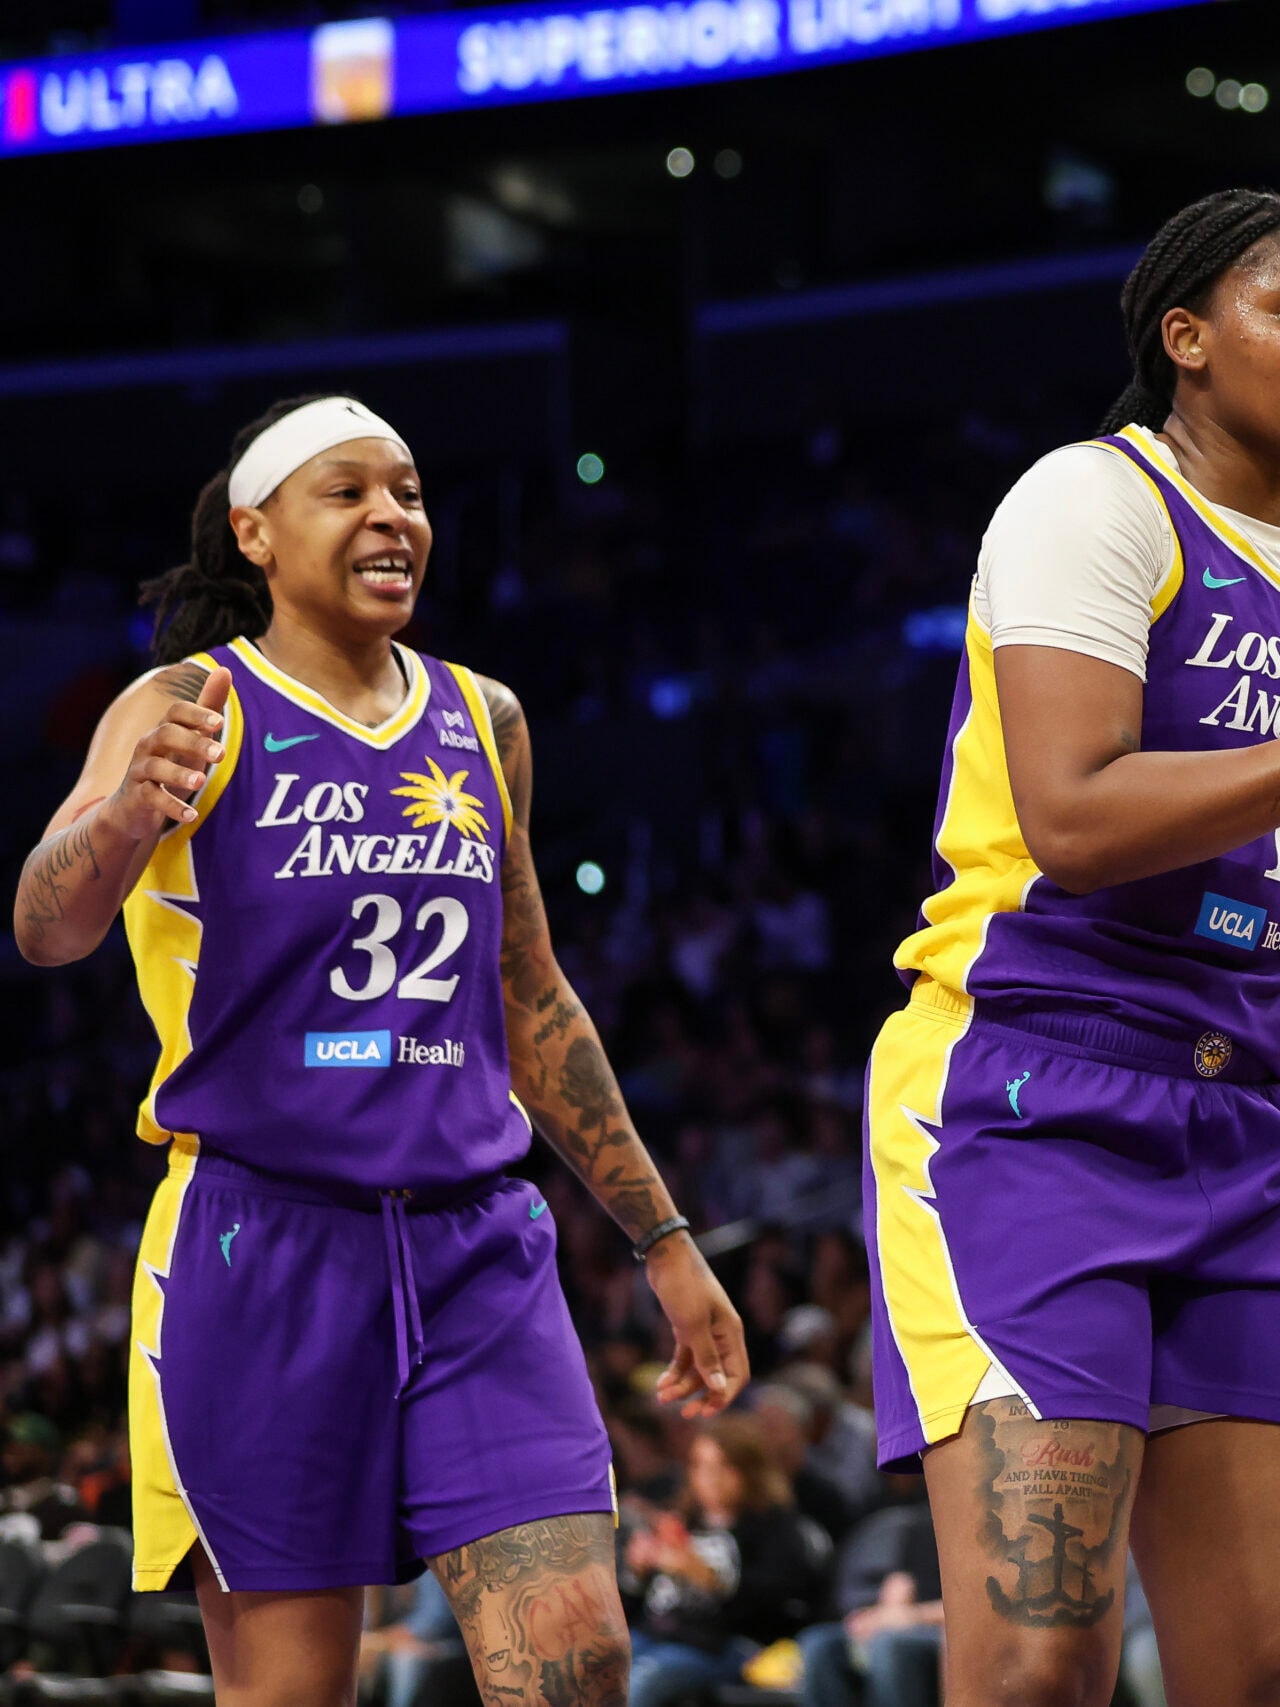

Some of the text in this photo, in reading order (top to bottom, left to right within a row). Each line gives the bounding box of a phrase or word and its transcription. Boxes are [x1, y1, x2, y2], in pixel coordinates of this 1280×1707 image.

[456, 0, 780, 94] SUPERIOR
[41, 53, 238, 137] ULTRA
[439, 728, 480, 753] Albert
[255, 773, 370, 828] LOS
[274, 822, 496, 884] ANGELES
[1209, 906, 1255, 941] UCLA
[329, 893, 469, 1002] 32
[316, 1035, 465, 1068] UCLA Health
[1008, 1405, 1029, 1417] INT
[1021, 1439, 1096, 1468] Rush
[1003, 1469, 1110, 1489] AND HAVE THINGS
[1023, 1484, 1093, 1498] FALL APART
